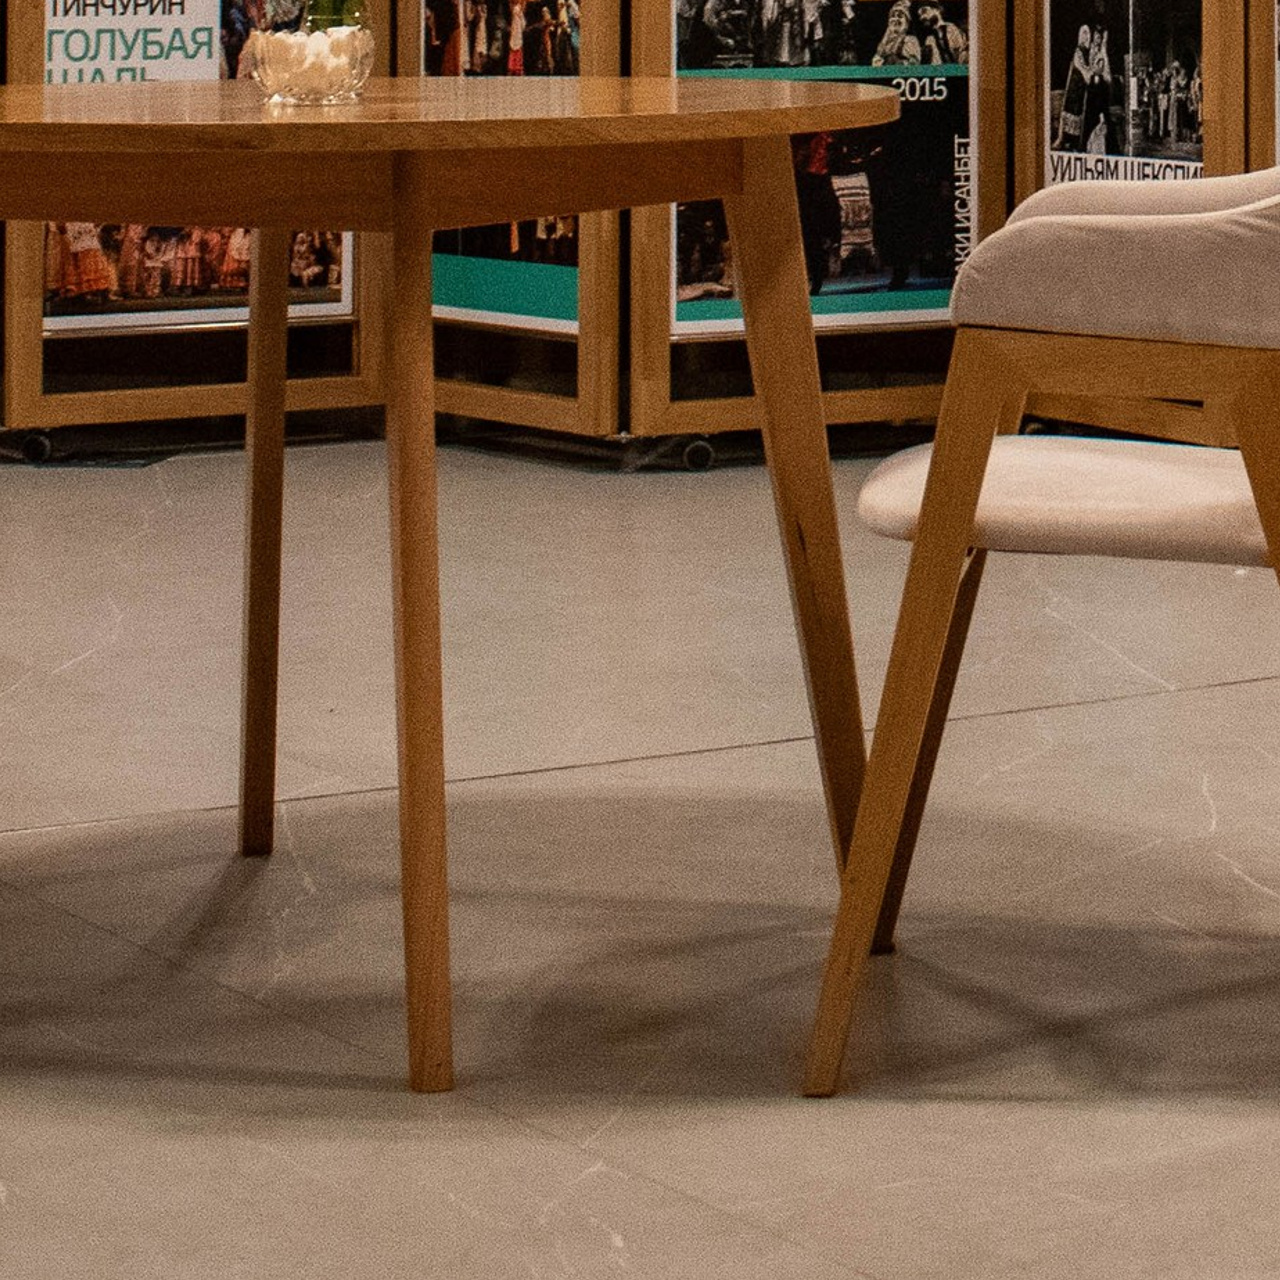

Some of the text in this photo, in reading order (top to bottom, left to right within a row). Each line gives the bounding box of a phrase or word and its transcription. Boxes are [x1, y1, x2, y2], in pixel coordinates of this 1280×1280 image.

[46, 26, 213, 62] ГОЛУБАЯ
[892, 78, 948, 102] 2015
[954, 134, 971, 227] ИСАНБЕТ
[1050, 154, 1120, 182] УИЛЬЯМ
